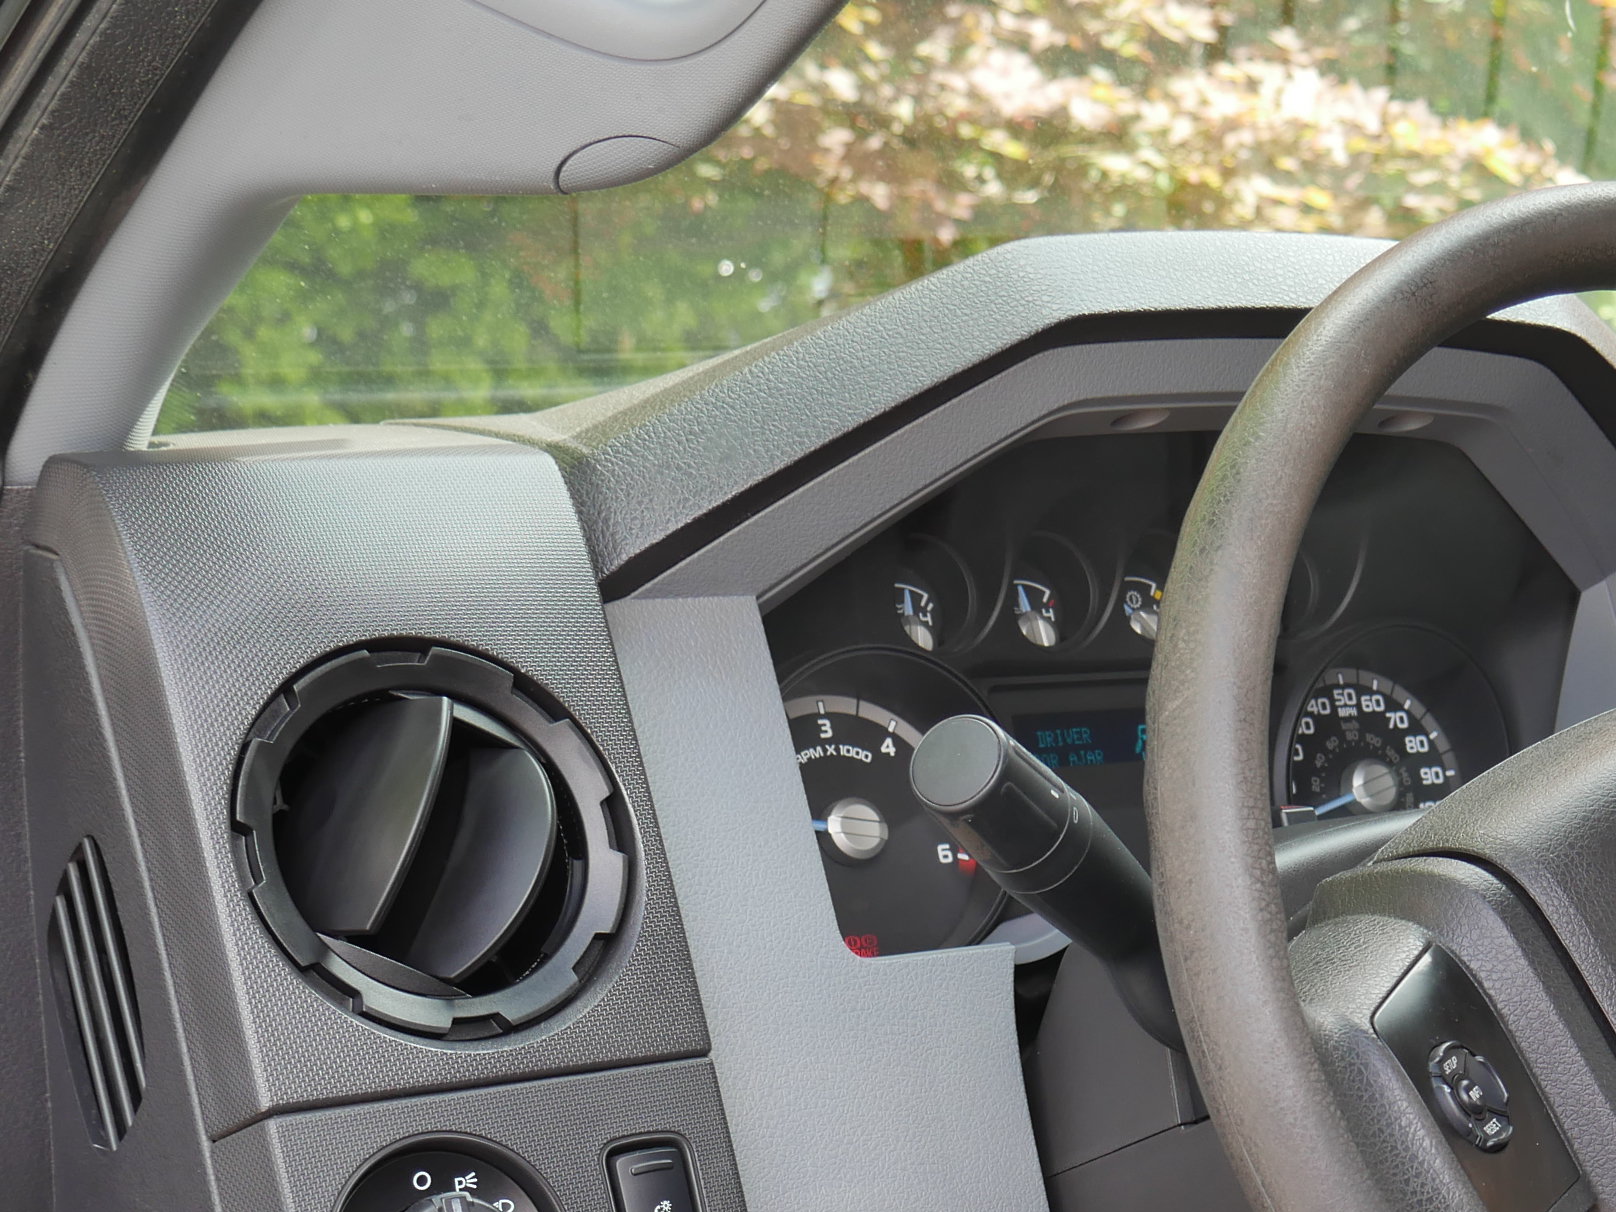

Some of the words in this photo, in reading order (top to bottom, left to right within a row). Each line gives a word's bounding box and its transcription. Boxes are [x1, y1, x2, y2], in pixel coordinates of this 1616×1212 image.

[1333, 688, 1357, 706] 50
[1360, 695, 1385, 712] 60
[1307, 698, 1331, 715] 40
[1337, 707, 1358, 717] MPH
[817, 718, 833, 739] 3
[1298, 717, 1315, 735] 0
[1386, 711, 1409, 729] 70
[1036, 727, 1093, 748] DRIVER
[1405, 735, 1429, 753] 80
[825, 744, 837, 757] X
[838, 744, 872, 763] 1000
[880, 737, 896, 757] 4
[1068, 749, 1104, 767] AJAR
[1420, 766, 1444, 785] 90
[936, 843, 953, 864] 6
[1442, 1055, 1458, 1075] SETUP
[1483, 1117, 1502, 1136] RESET
